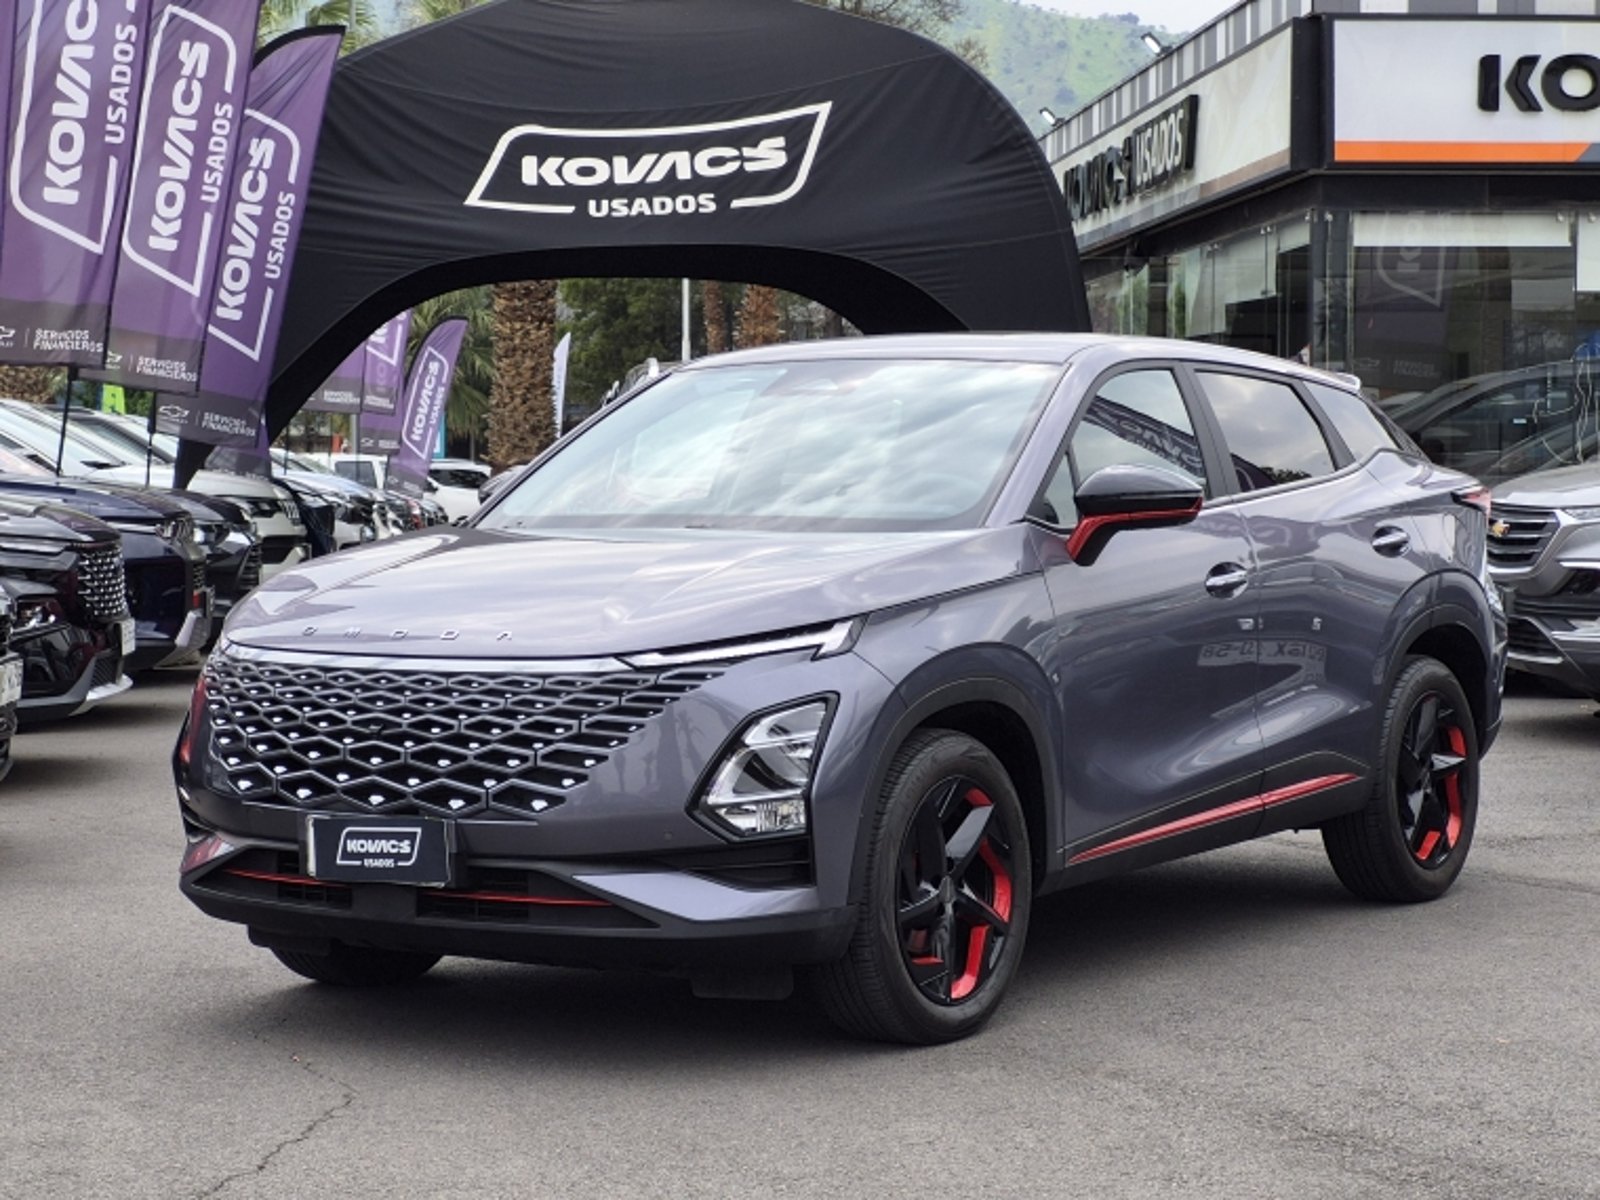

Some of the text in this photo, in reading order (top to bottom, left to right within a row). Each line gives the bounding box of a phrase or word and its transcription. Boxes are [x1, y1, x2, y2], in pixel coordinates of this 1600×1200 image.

[104, 22, 138, 144] USADOS
[1477, 54, 1600, 112] KO
[148, 40, 210, 251] KOVACS
[200, 102, 233, 203] USADOS
[521, 136, 788, 187] KOVACS
[215, 137, 276, 321] KOVACS
[264, 191, 296, 279] USADOS
[588, 193, 717, 218] USADOS
[33, 340, 104, 352] FINANCIEROS
[35, 328, 89, 340] SERVICIOS
[410, 361, 440, 440] KOVACS
[346, 839, 412, 854] KOVACS
